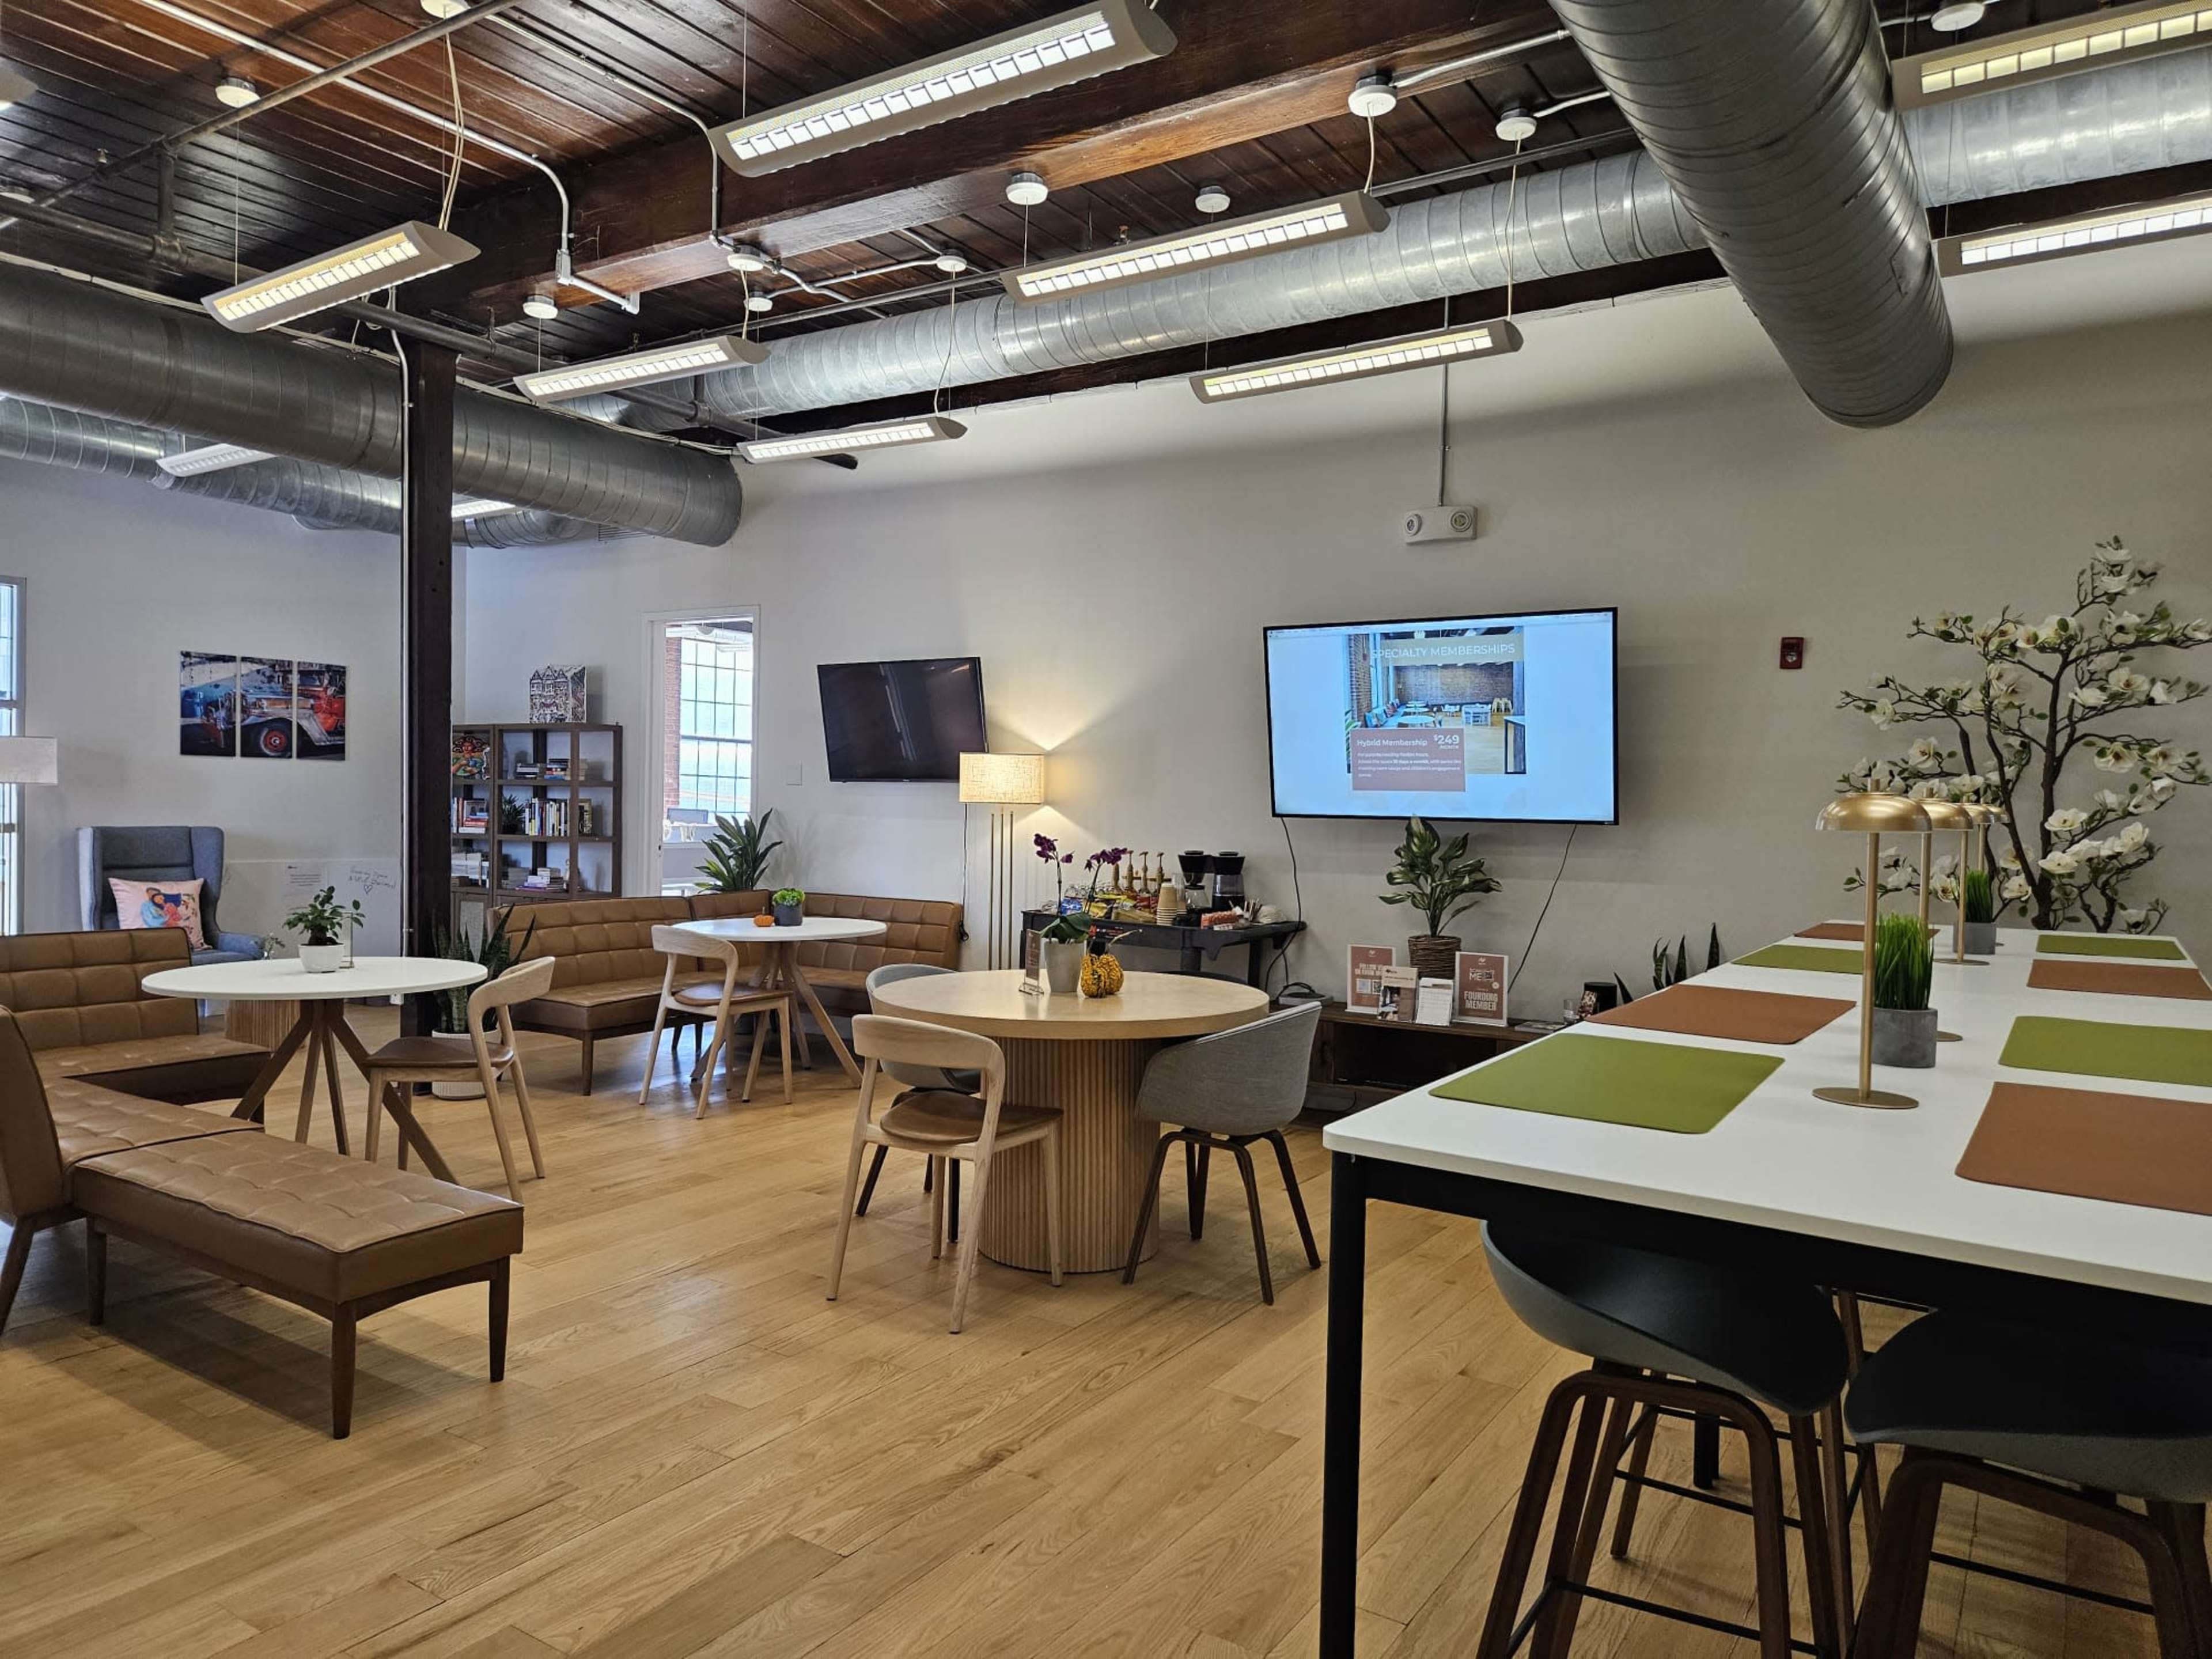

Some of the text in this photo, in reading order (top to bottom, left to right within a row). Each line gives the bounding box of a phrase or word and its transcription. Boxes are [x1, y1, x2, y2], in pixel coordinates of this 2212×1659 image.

[1371, 643, 1516, 659] SPECIALTY MEMBERSHIPS
[1357, 738, 1427, 747] Hybrid Membership
[1433, 734, 1460, 744] $249
[1464, 991, 1498, 1002] FOUNDING
[1465, 999, 1497, 1011] MEMBER
